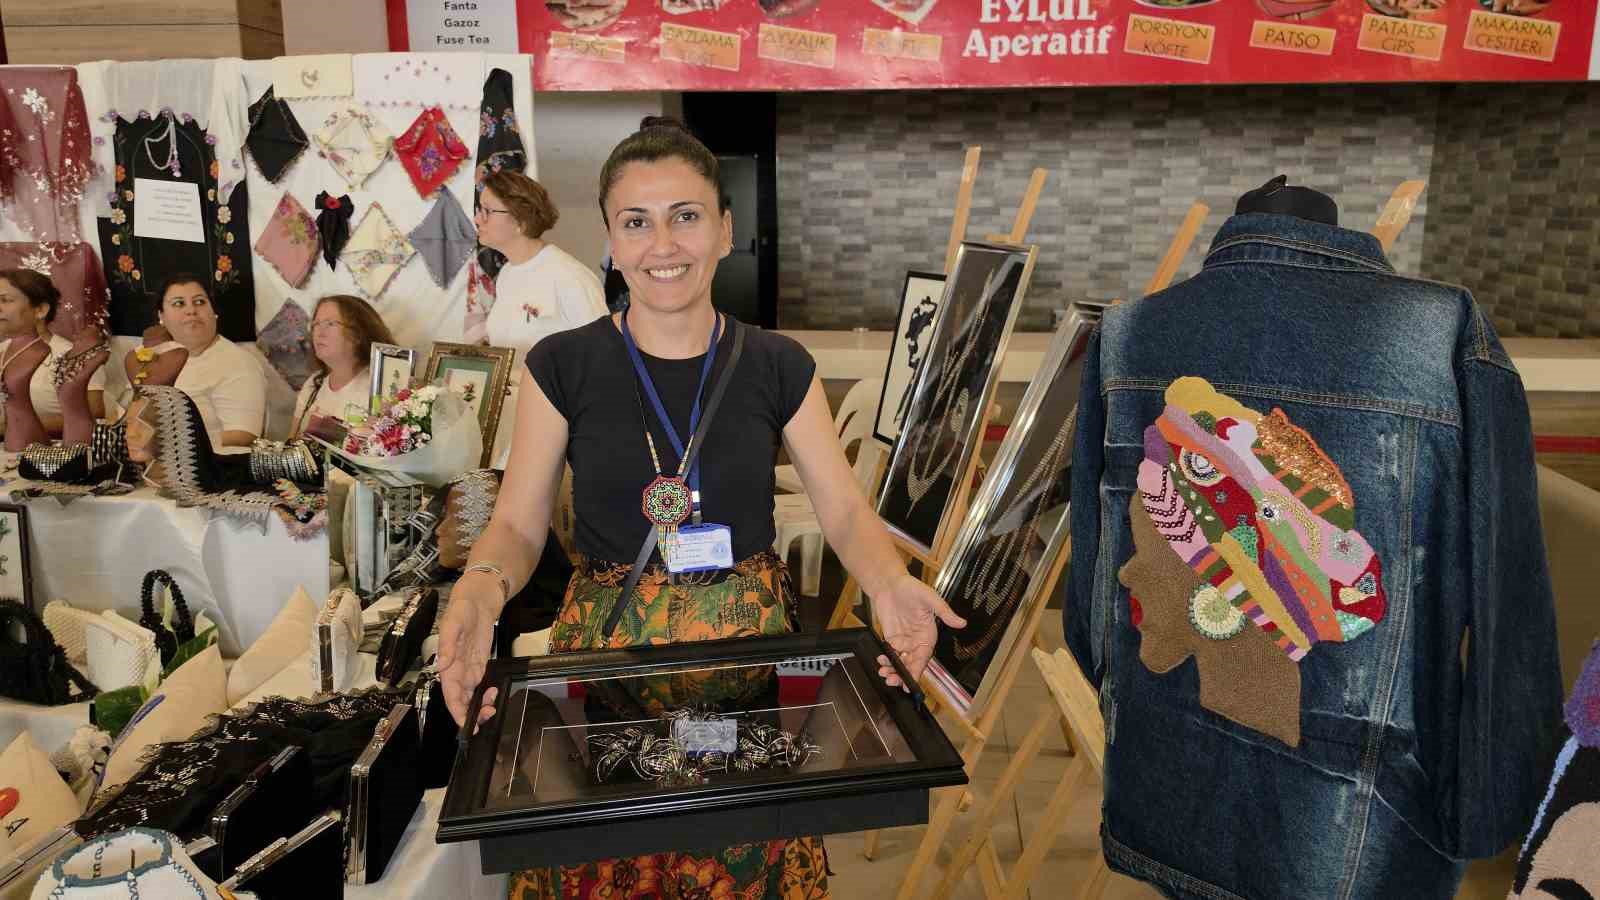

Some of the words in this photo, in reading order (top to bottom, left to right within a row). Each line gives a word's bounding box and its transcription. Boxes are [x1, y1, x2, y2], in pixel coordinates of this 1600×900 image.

[444, 1, 478, 11] Fanta
[444, 18, 481, 28] Gazoz
[1367, 17, 1435, 41] PATATES
[1472, 16, 1553, 37] MAKARNA
[436, 35, 465, 45] Fuse
[469, 35, 490, 45] Tea
[962, 25, 1114, 63] Aperatif
[1143, 38, 1188, 57] KÖFTE
[1264, 28, 1321, 50] PATSO
